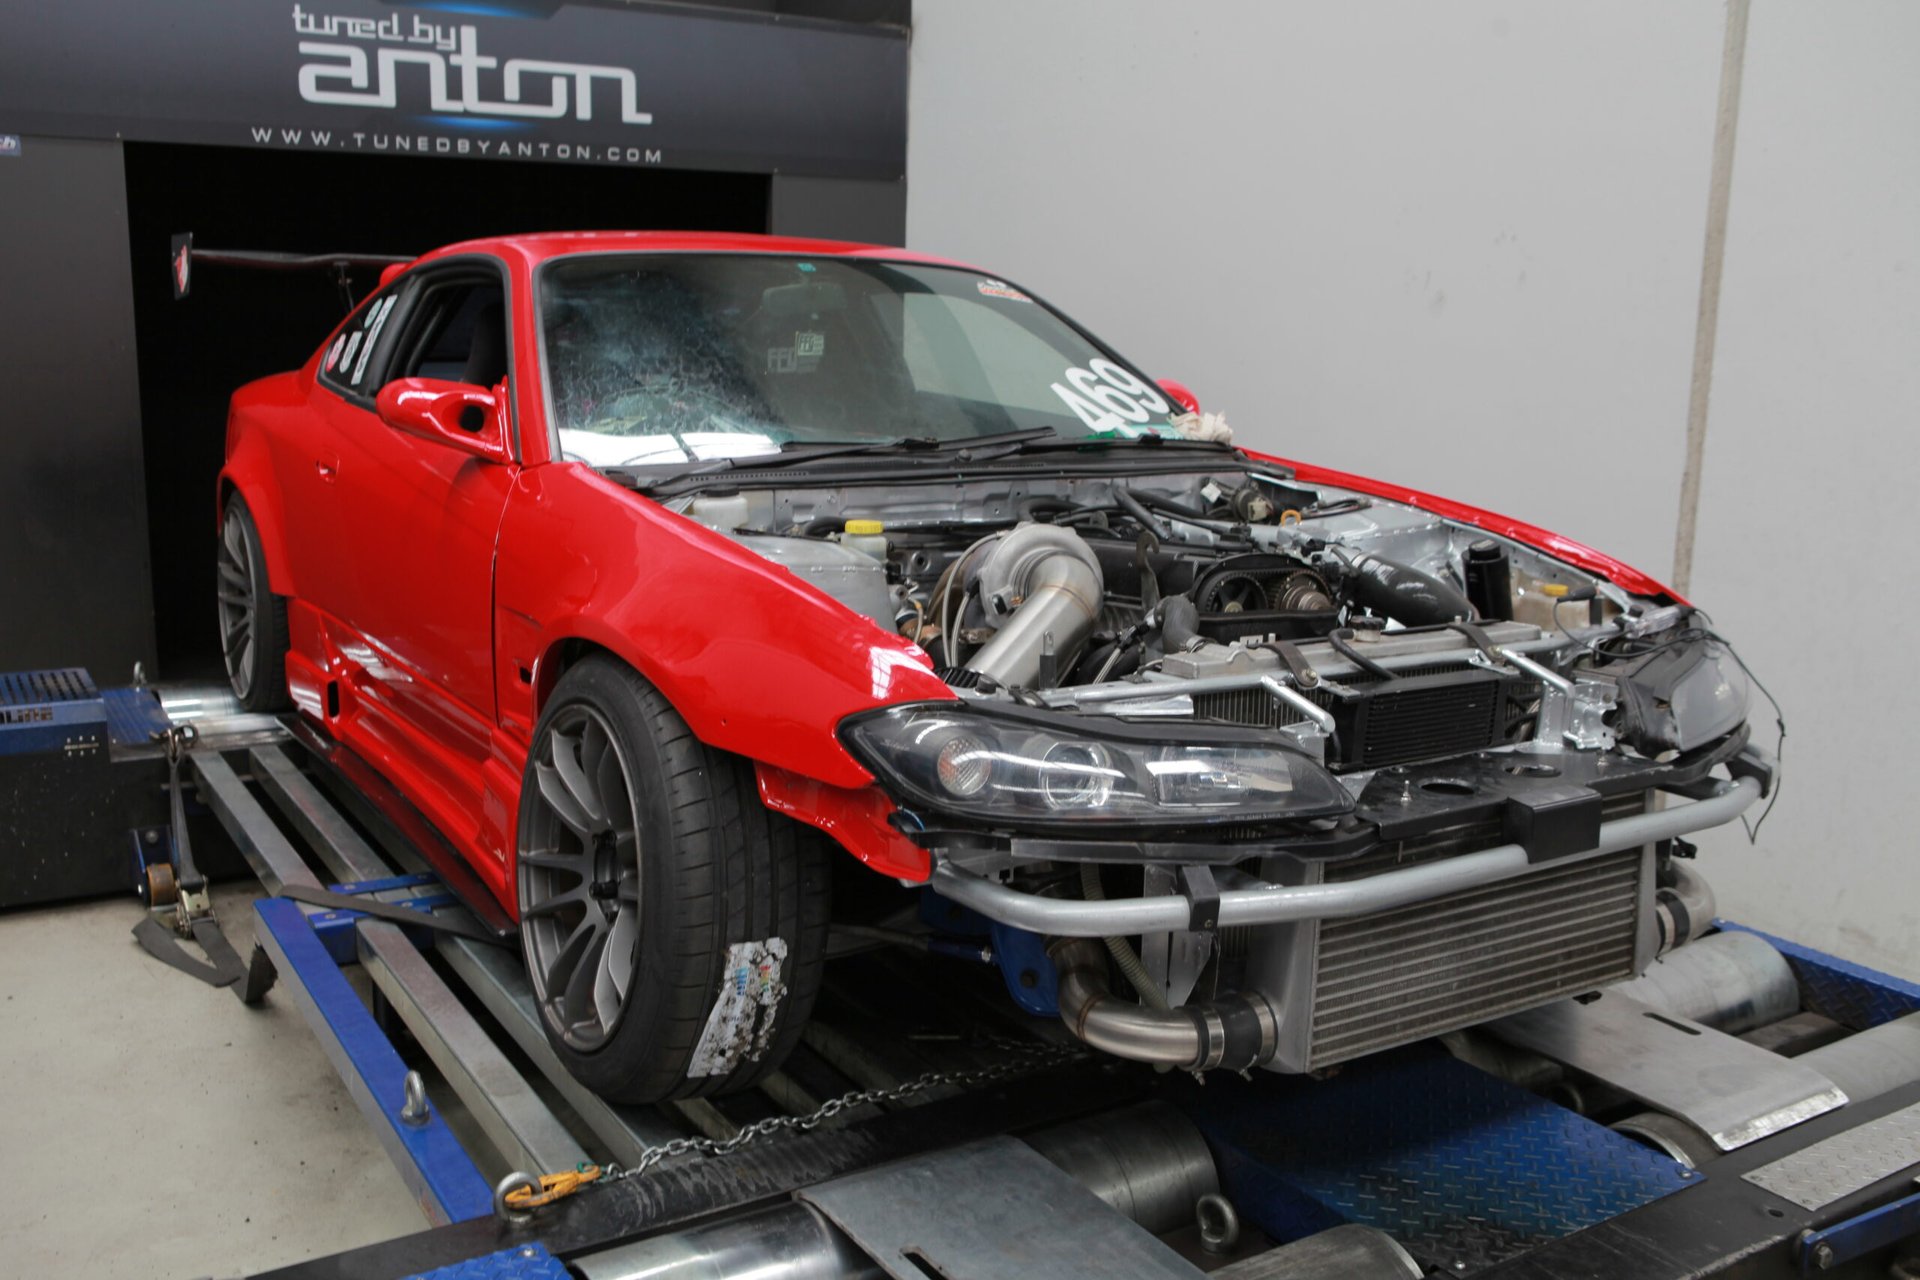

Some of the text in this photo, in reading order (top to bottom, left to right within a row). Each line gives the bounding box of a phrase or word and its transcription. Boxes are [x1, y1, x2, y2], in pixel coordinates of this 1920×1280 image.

[292, 3, 457, 51] tuned by
[298, 25, 653, 125] anton
[251, 127, 662, 163] WWW.TUNEDBYANTON.COM
[1050, 357, 1171, 439] 469
